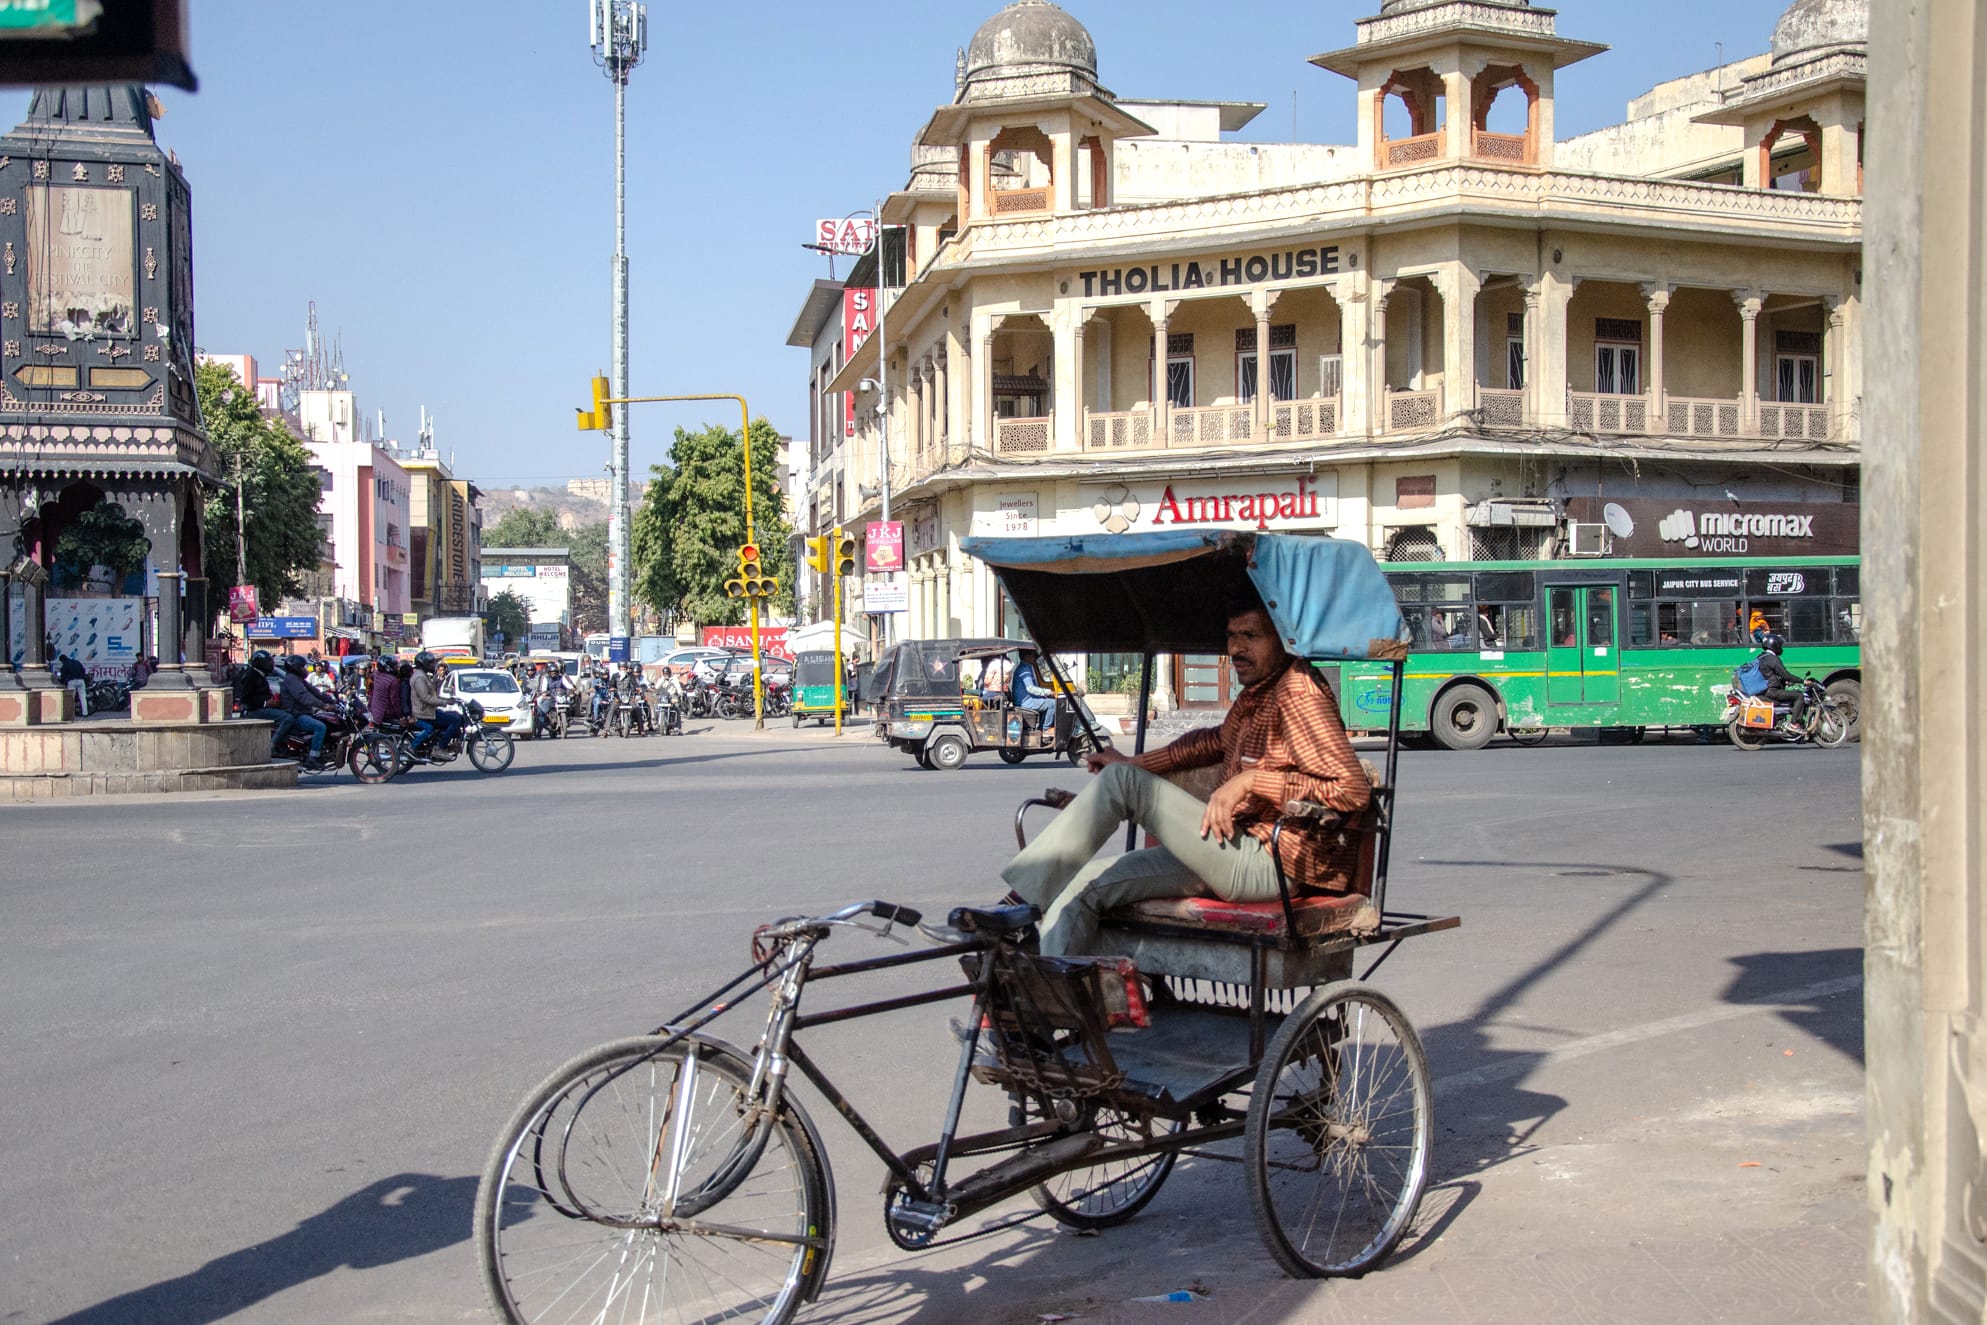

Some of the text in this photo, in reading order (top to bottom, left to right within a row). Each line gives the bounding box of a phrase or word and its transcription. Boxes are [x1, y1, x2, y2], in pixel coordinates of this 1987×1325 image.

[1079, 245, 1339, 298] THOLIA HOUSE
[1000, 498, 1034, 510] Jewellers
[1151, 476, 1320, 529] Amrapali
[1005, 522, 1029, 532] 1978
[1700, 513, 1814, 537] micromax
[1701, 537, 1748, 553] WORLD
[1662, 579, 1739, 589] JAIPUR CITY BUS SERVICE
